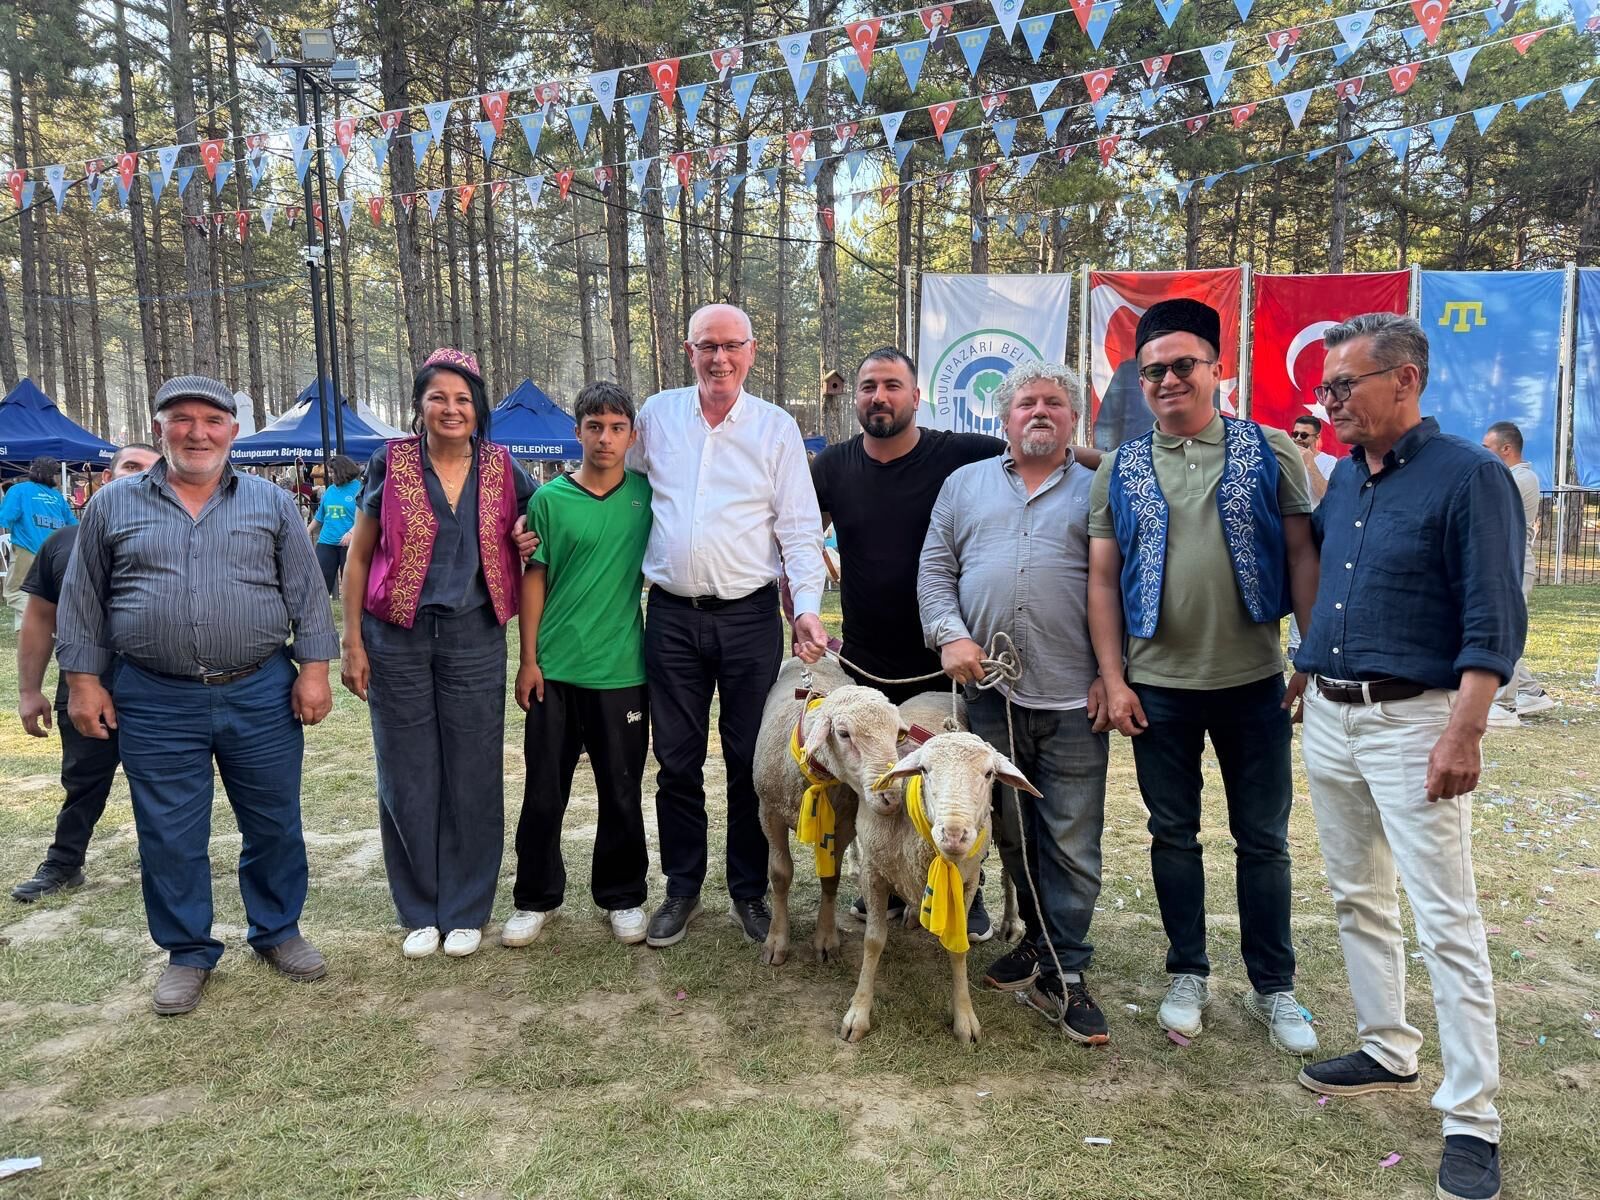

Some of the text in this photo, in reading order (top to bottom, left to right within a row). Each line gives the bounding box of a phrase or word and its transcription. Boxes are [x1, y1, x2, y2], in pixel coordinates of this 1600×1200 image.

[937, 341, 992, 415] ODUNPAZARI
[231, 448, 279, 459] Odunpazarı
[281, 447, 312, 457] Birlikte
[512, 444, 563, 454] BELEDİYESİ
